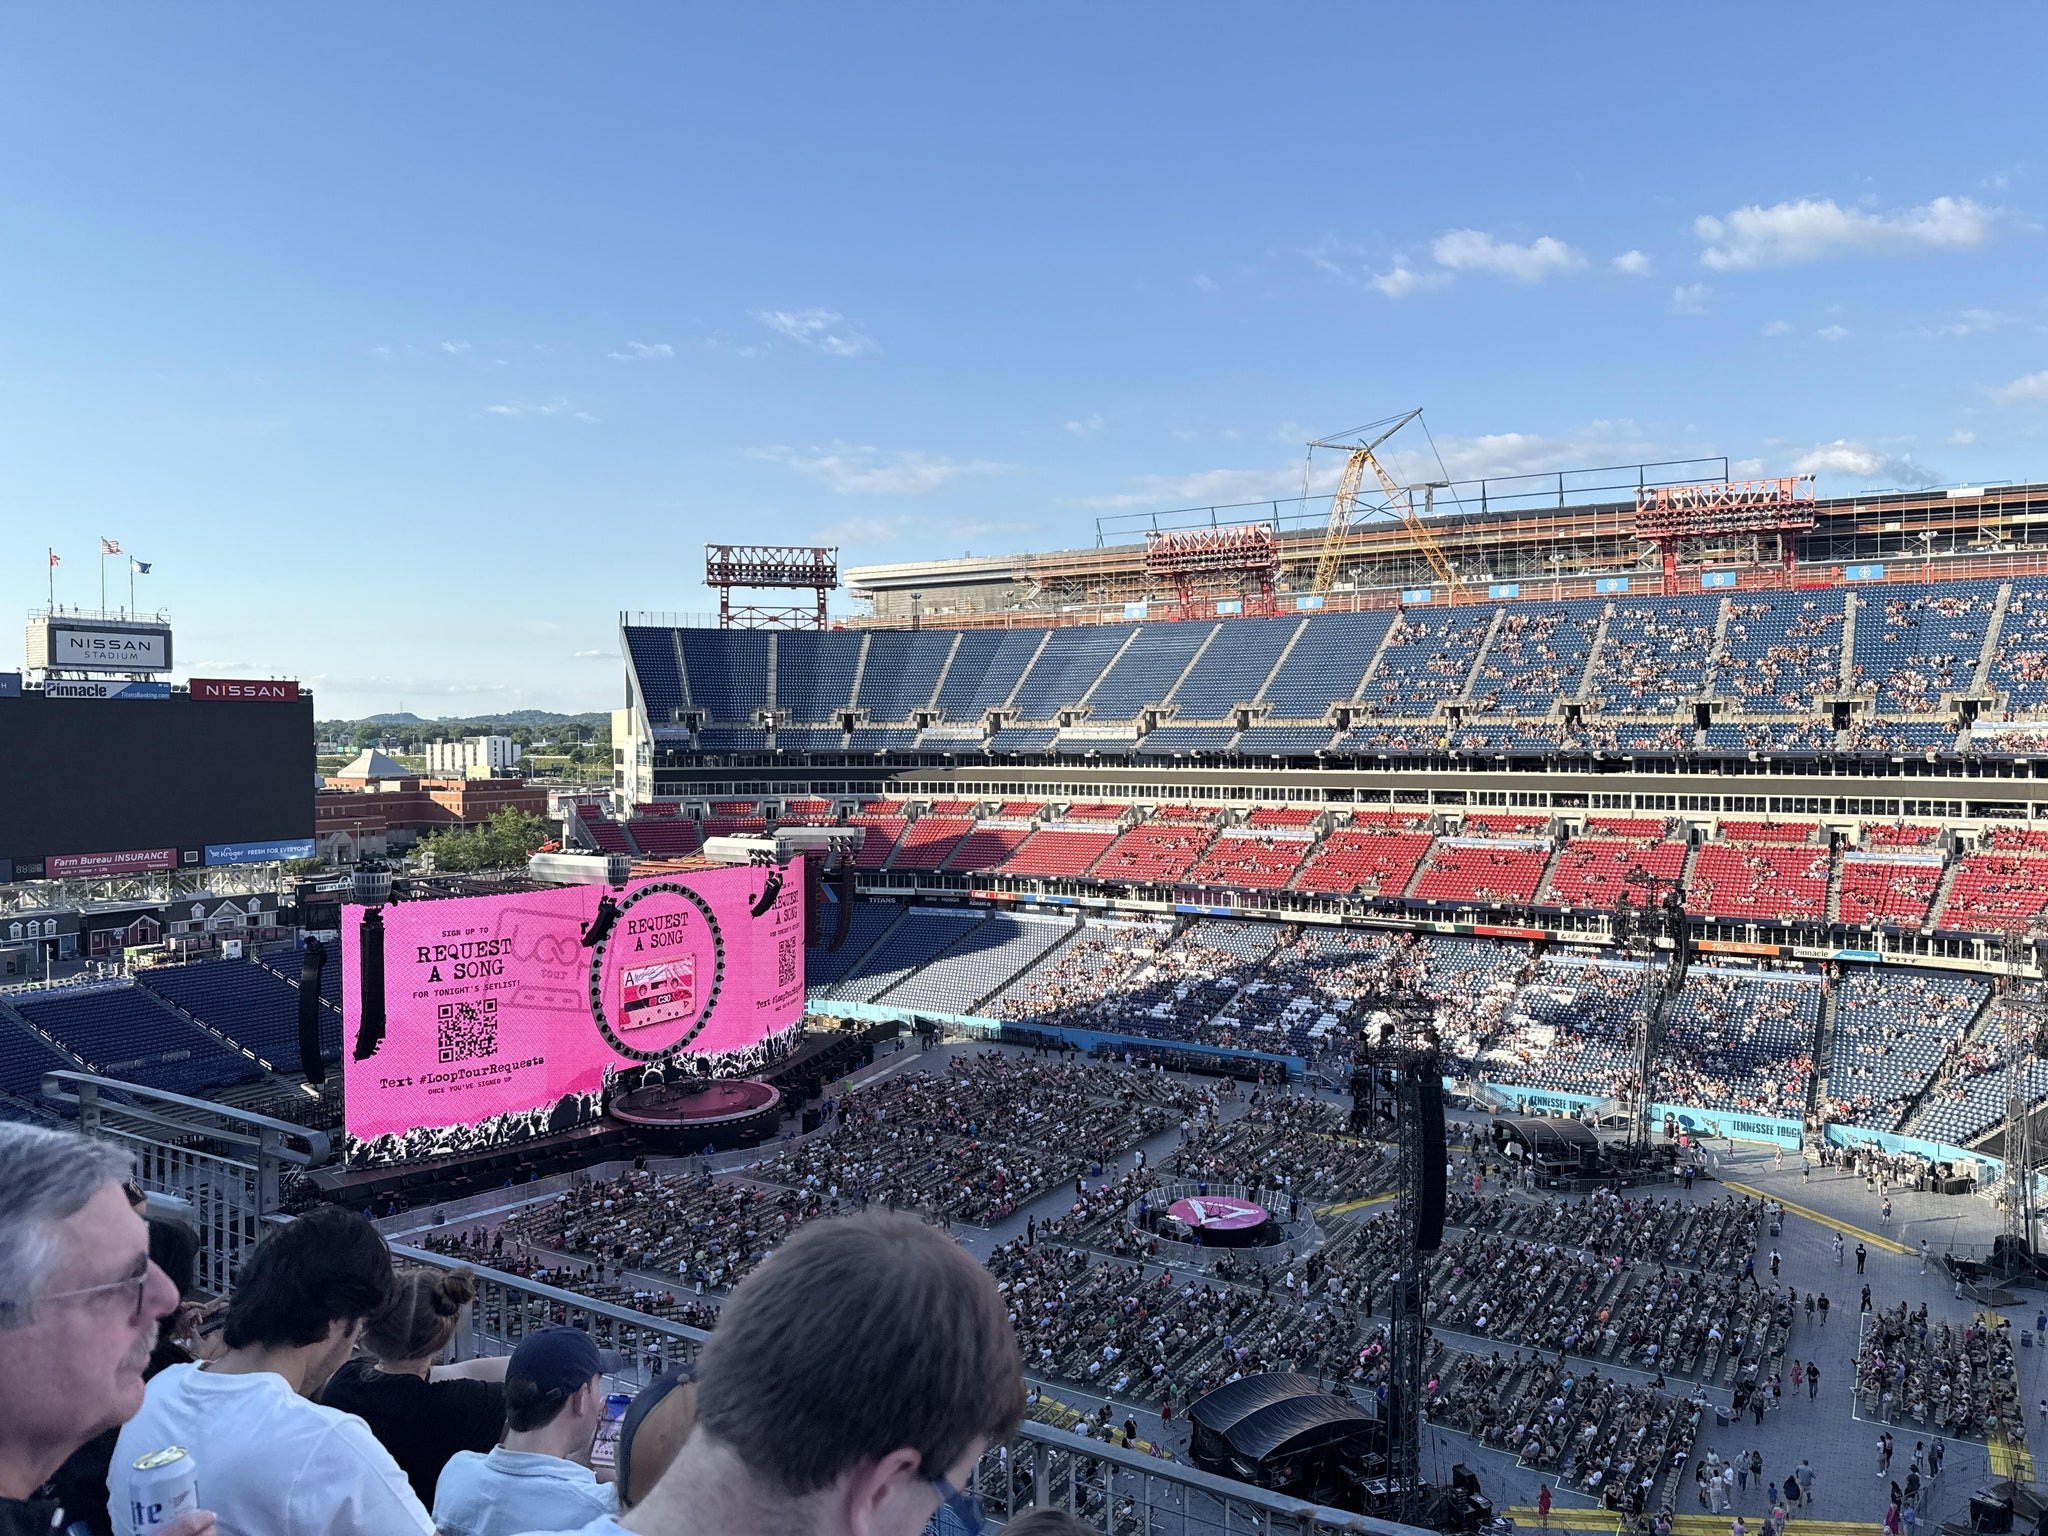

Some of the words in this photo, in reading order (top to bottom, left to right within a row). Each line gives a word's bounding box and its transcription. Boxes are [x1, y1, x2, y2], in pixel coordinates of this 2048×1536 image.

[70, 637, 151, 651] NISSAN
[84, 651, 138, 660] STADIUM
[47, 682, 107, 697] Pinnacle
[206, 685, 285, 697] NISSAN
[54, 858, 78, 867] Farm
[80, 854, 113, 865] Bureau
[114, 851, 169, 862] INSURANCE
[221, 847, 244, 860] Kroger
[247, 848, 266, 856] FRESH
[627, 912, 689, 935] REQUEST
[442, 930, 461, 938] SIGN
[634, 937, 645, 952] A
[650, 930, 684, 949] SONG
[416, 938, 512, 964] REQUEST
[1795, 948, 1829, 957] Pinnacle
[427, 965, 443, 983] A
[453, 959, 505, 980] SONG
[625, 971, 635, 987] A
[412, 991, 429, 999] FOR
[434, 985, 480, 997] TONIGHT'S
[483, 980, 521, 991] SETLIST!
[379, 1076, 413, 1089] Text
[419, 1056, 545, 1085] #LoopTourRequests
[427, 1087, 445, 1095] ONCE
[450, 1083, 474, 1092] YOU'VE
[477, 1079, 501, 1088] SIGNED
[1530, 1095, 1567, 1109] TENNESSEE
[1733, 1120, 1774, 1136] TENNESSEE
